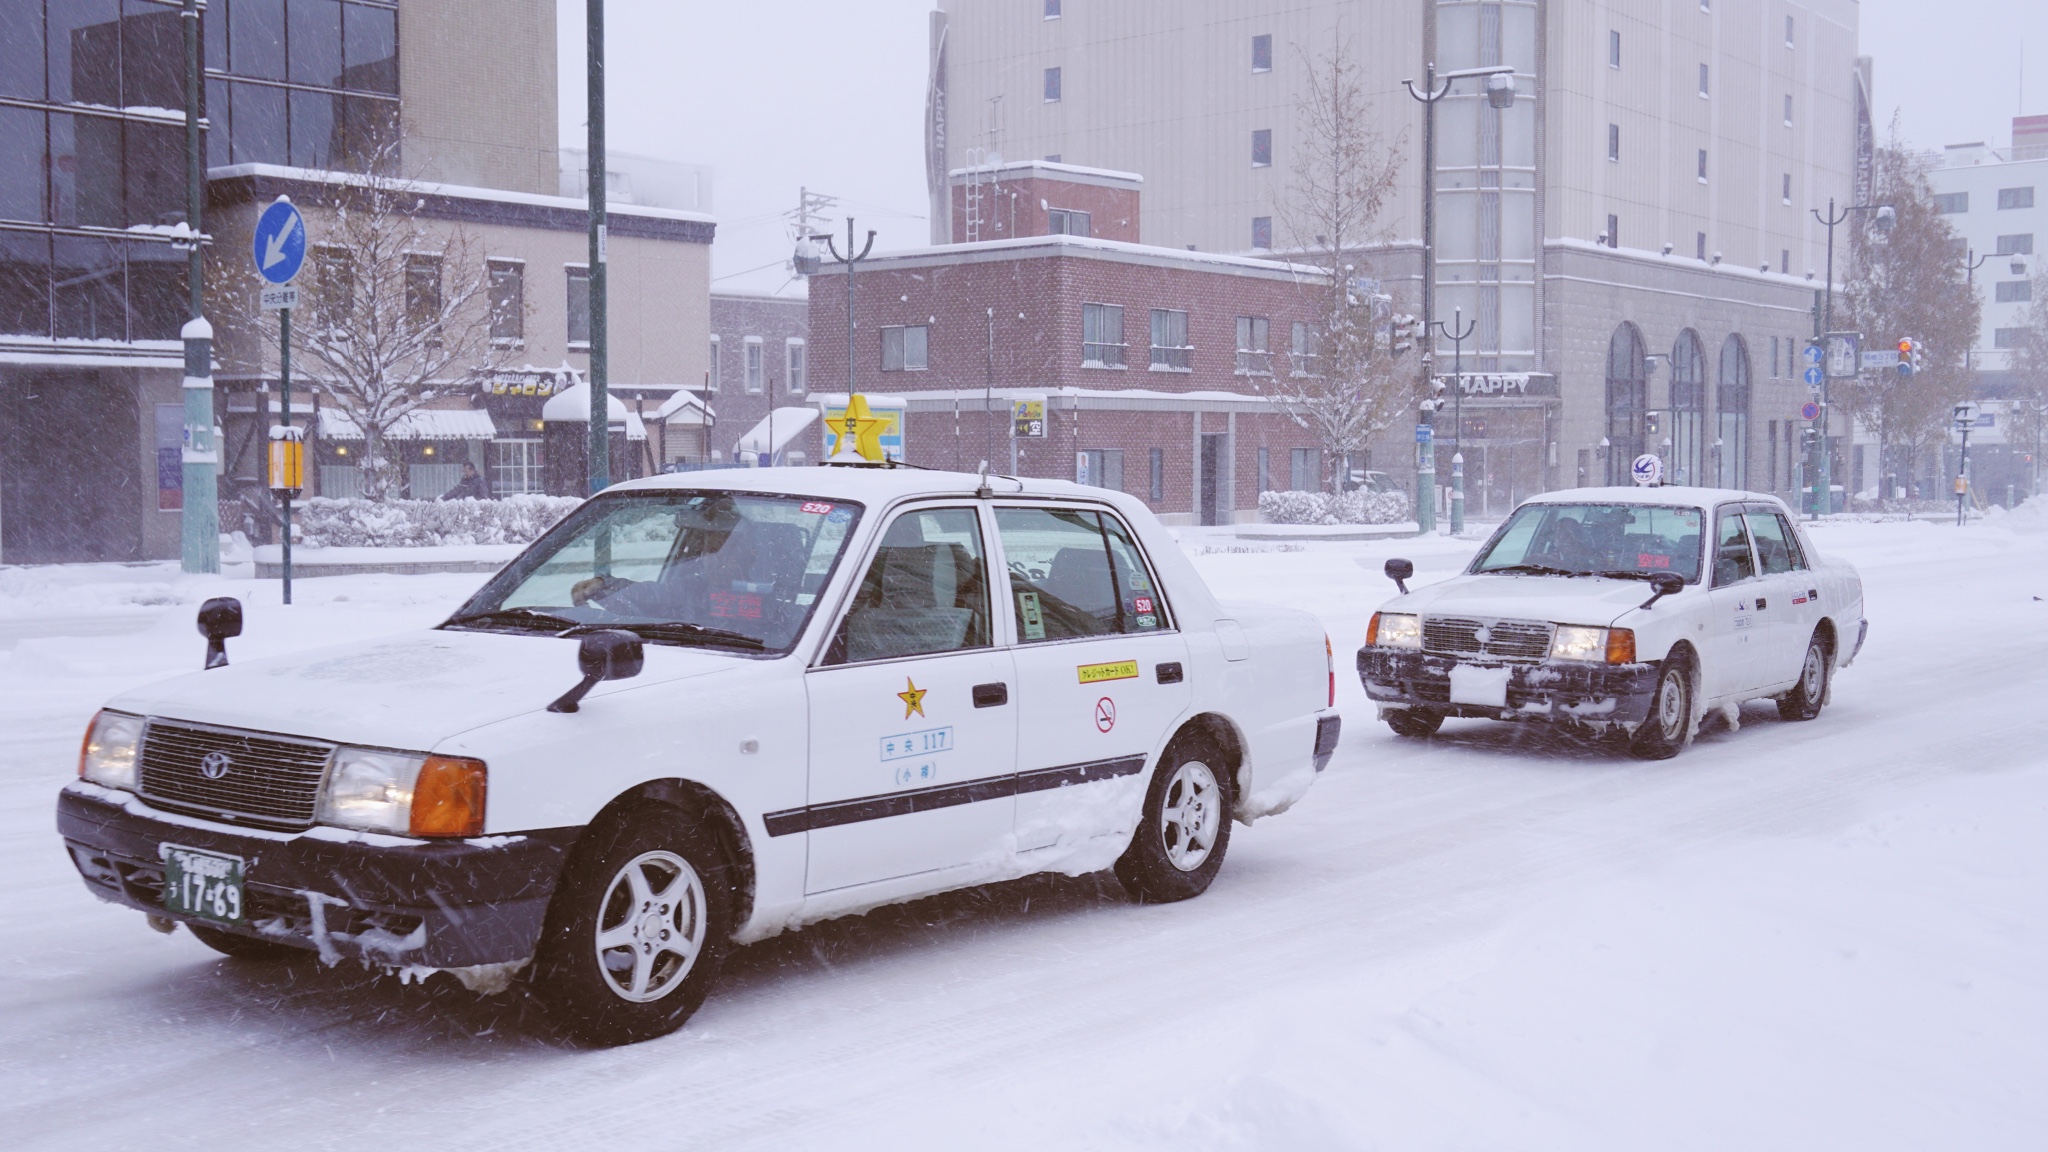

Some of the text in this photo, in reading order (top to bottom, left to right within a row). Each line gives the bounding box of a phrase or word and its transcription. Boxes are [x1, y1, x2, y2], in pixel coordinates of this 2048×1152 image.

[936, 86, 945, 149] HAPPY
[263, 291, 296, 304] 中央分離帯
[1455, 375, 1530, 394] HAPPY
[1029, 420, 1041, 436] 空
[802, 502, 832, 514] 520
[709, 590, 763, 620] 空車
[1136, 599, 1152, 612] 520
[909, 693, 918, 709] 中央
[886, 732, 946, 756] 中央 117
[182, 873, 241, 919] 17-69
